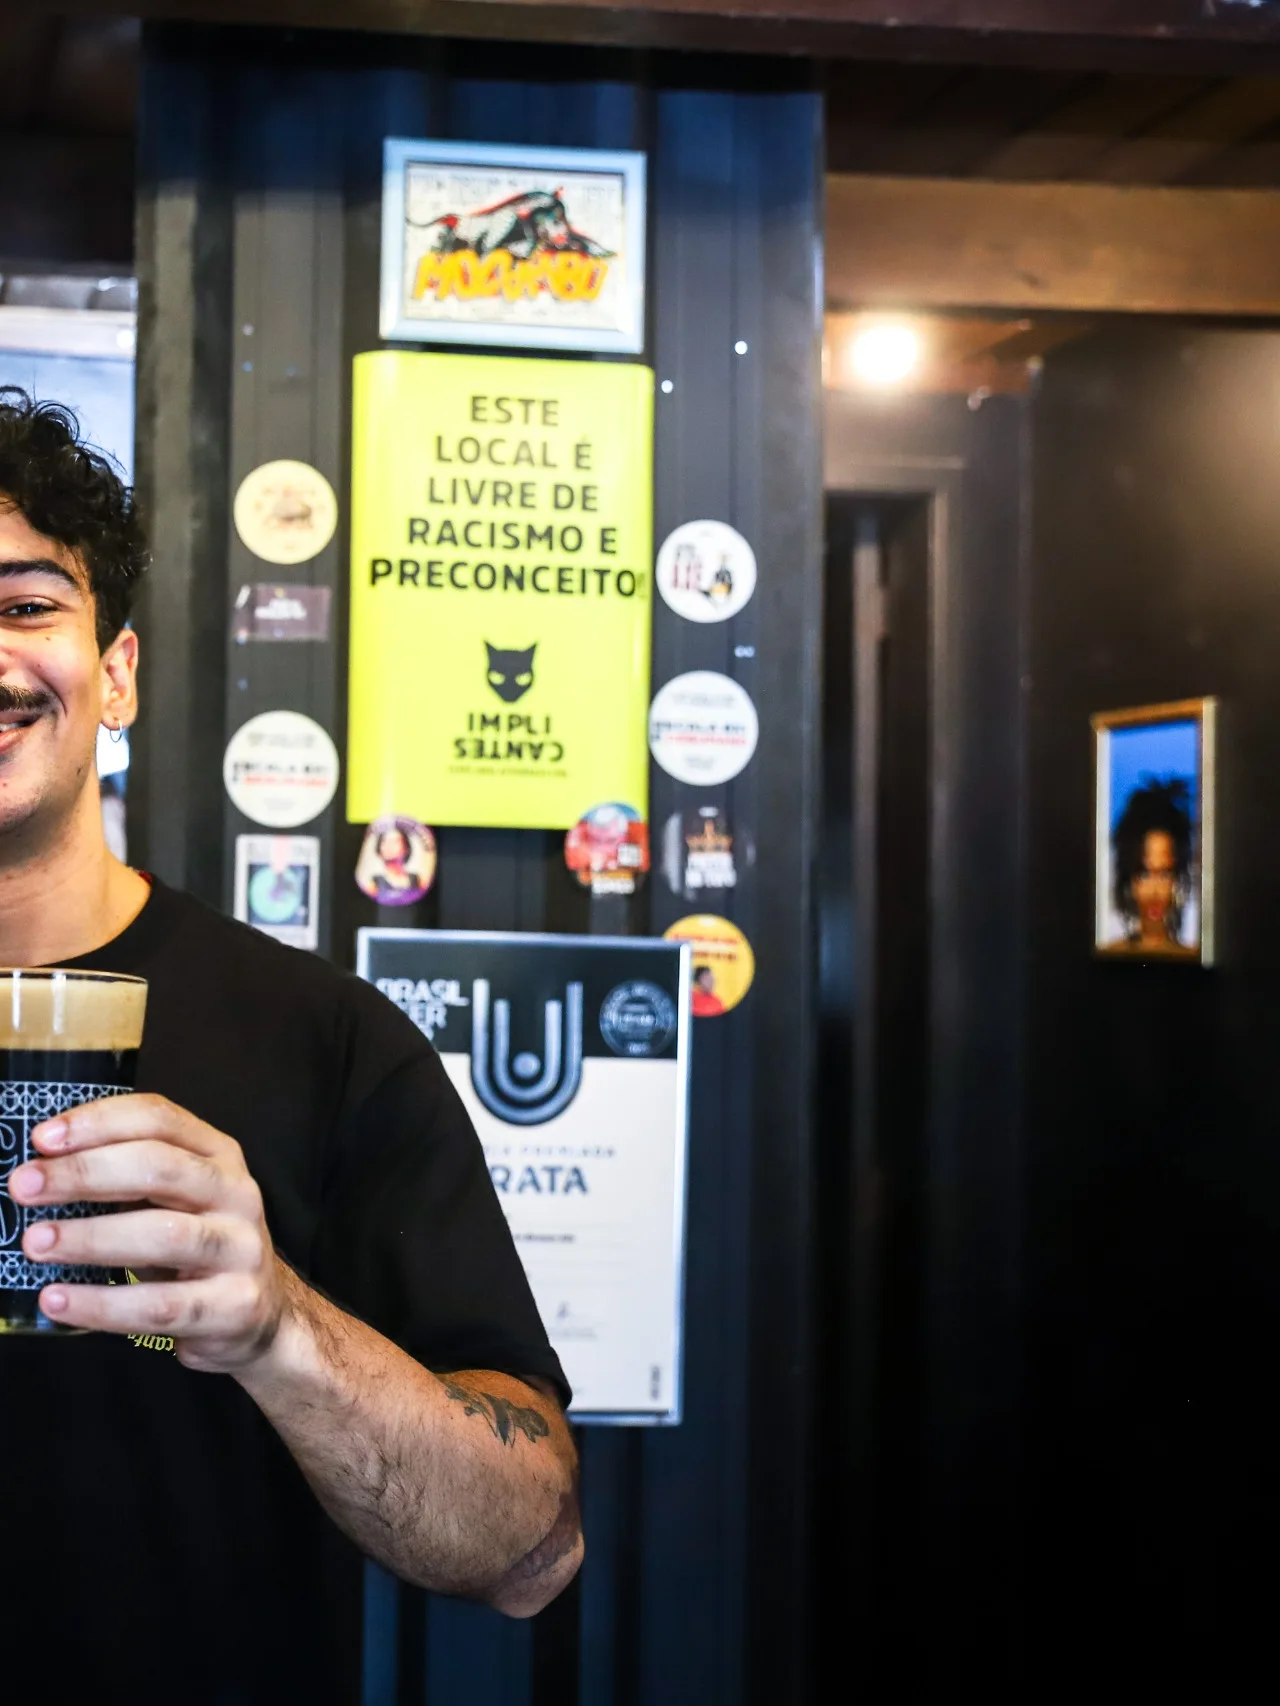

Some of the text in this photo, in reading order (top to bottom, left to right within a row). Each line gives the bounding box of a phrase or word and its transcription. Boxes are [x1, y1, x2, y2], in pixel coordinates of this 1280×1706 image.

[471, 396, 560, 426] ESTE
[435, 433, 592, 470] LOCAL É
[428, 477, 598, 512] LIVRE DE
[408, 518, 617, 554] RACISMO E
[468, 713, 550, 734] IMPLI
[490, 1165, 588, 1195] RATA
